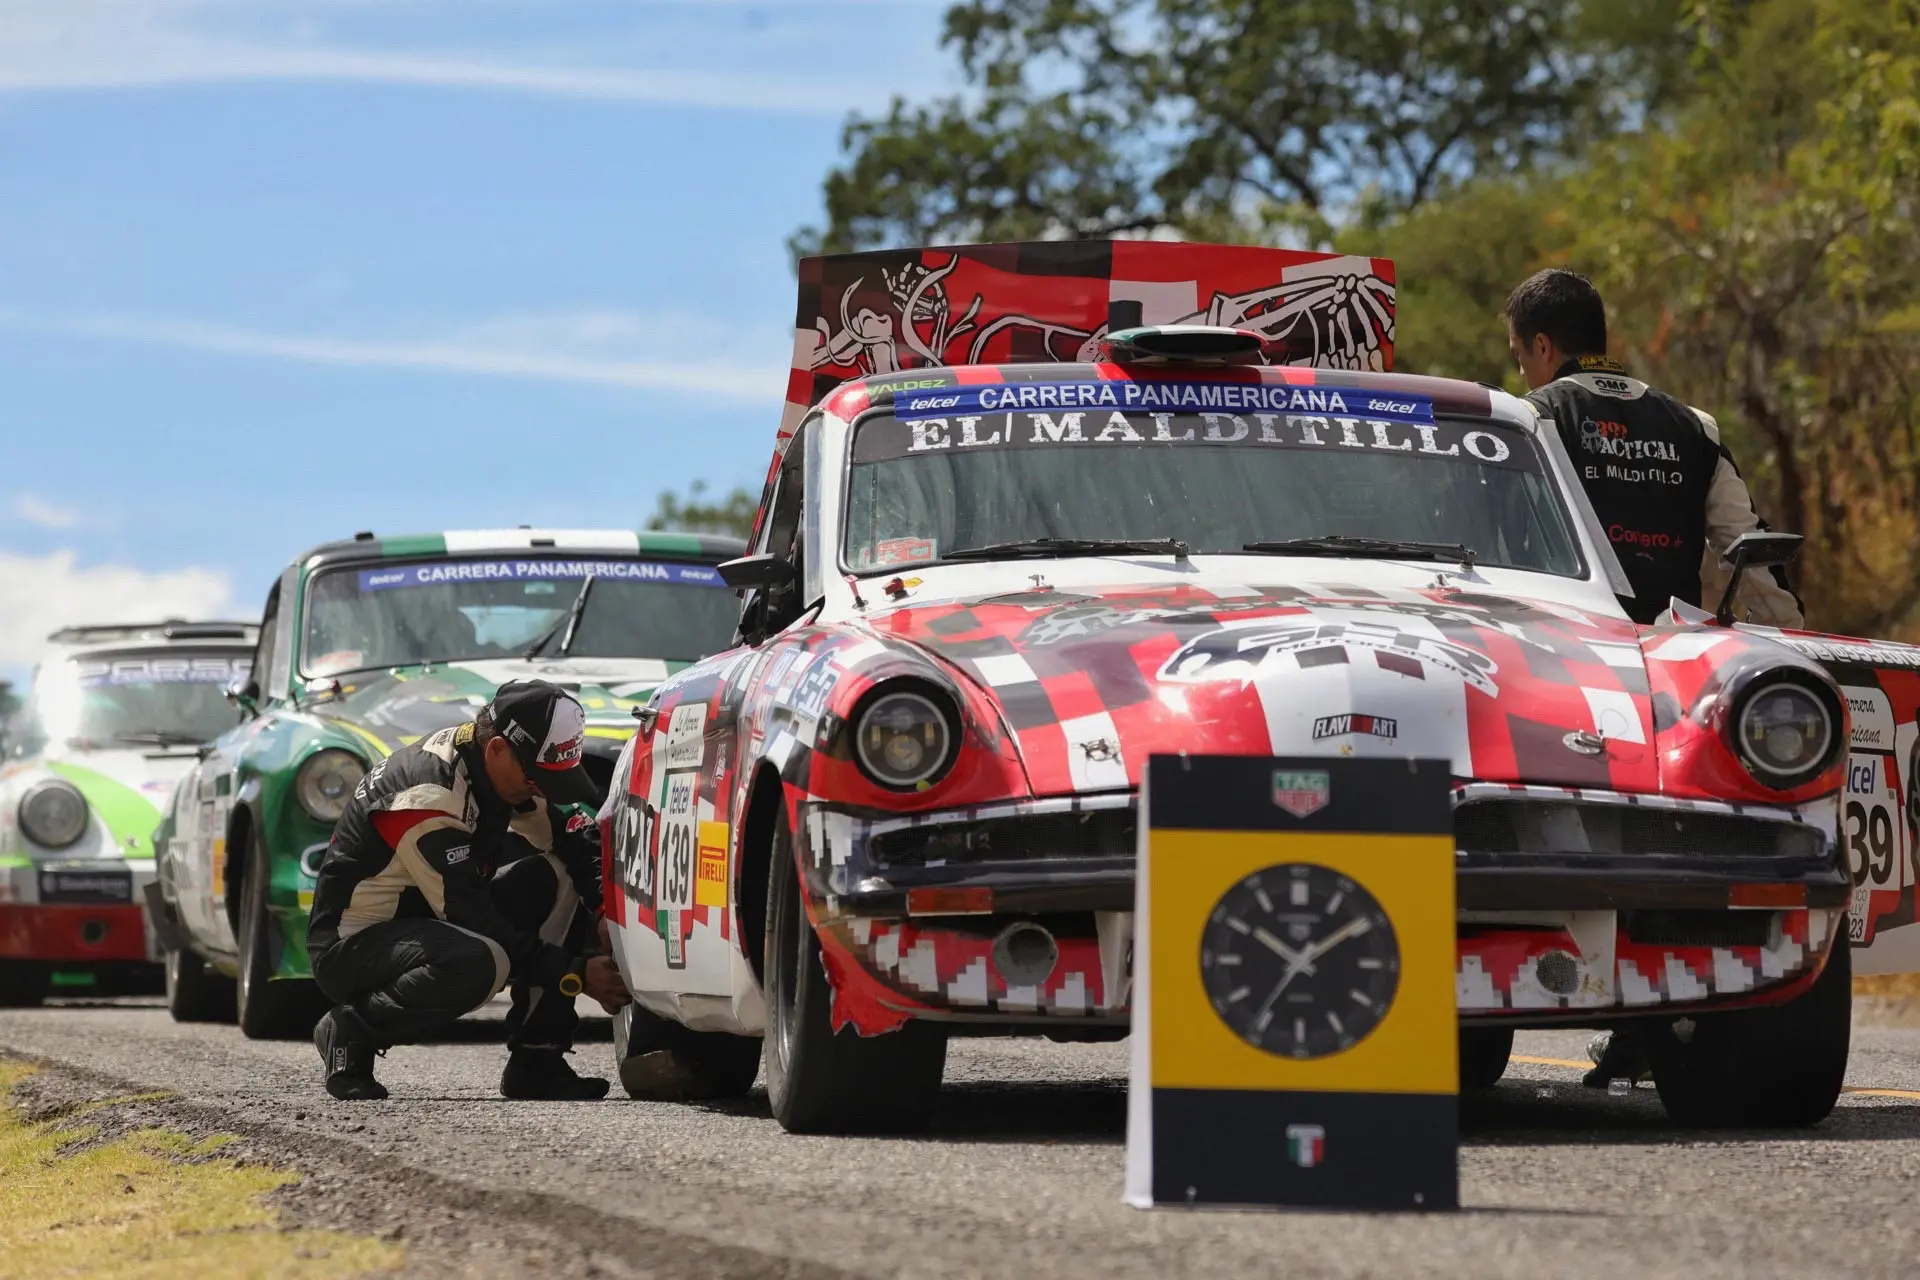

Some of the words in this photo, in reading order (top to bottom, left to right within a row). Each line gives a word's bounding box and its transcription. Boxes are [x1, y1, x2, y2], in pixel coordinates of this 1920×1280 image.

[866, 379, 946, 396] VALDEZ
[1595, 380, 1629, 391] OMP
[910, 395, 960, 411] telcel
[979, 384, 1118, 410] CARRERA
[1125, 384, 1348, 413] PANAMERICANA
[1368, 398, 1416, 414] telcel
[905, 416, 1001, 451] EL
[1027, 411, 1511, 463] MALDITILLO
[1585, 466, 1599, 479] EL
[417, 563, 513, 582] CARRERA
[516, 562, 669, 580] PANAMERICANA
[1372, 718, 1396, 738] ART
[1276, 772, 1327, 790] TAG
[446, 847, 470, 862] OMP
[661, 820, 690, 906] 139
[699, 845, 726, 884] PIRELLI
